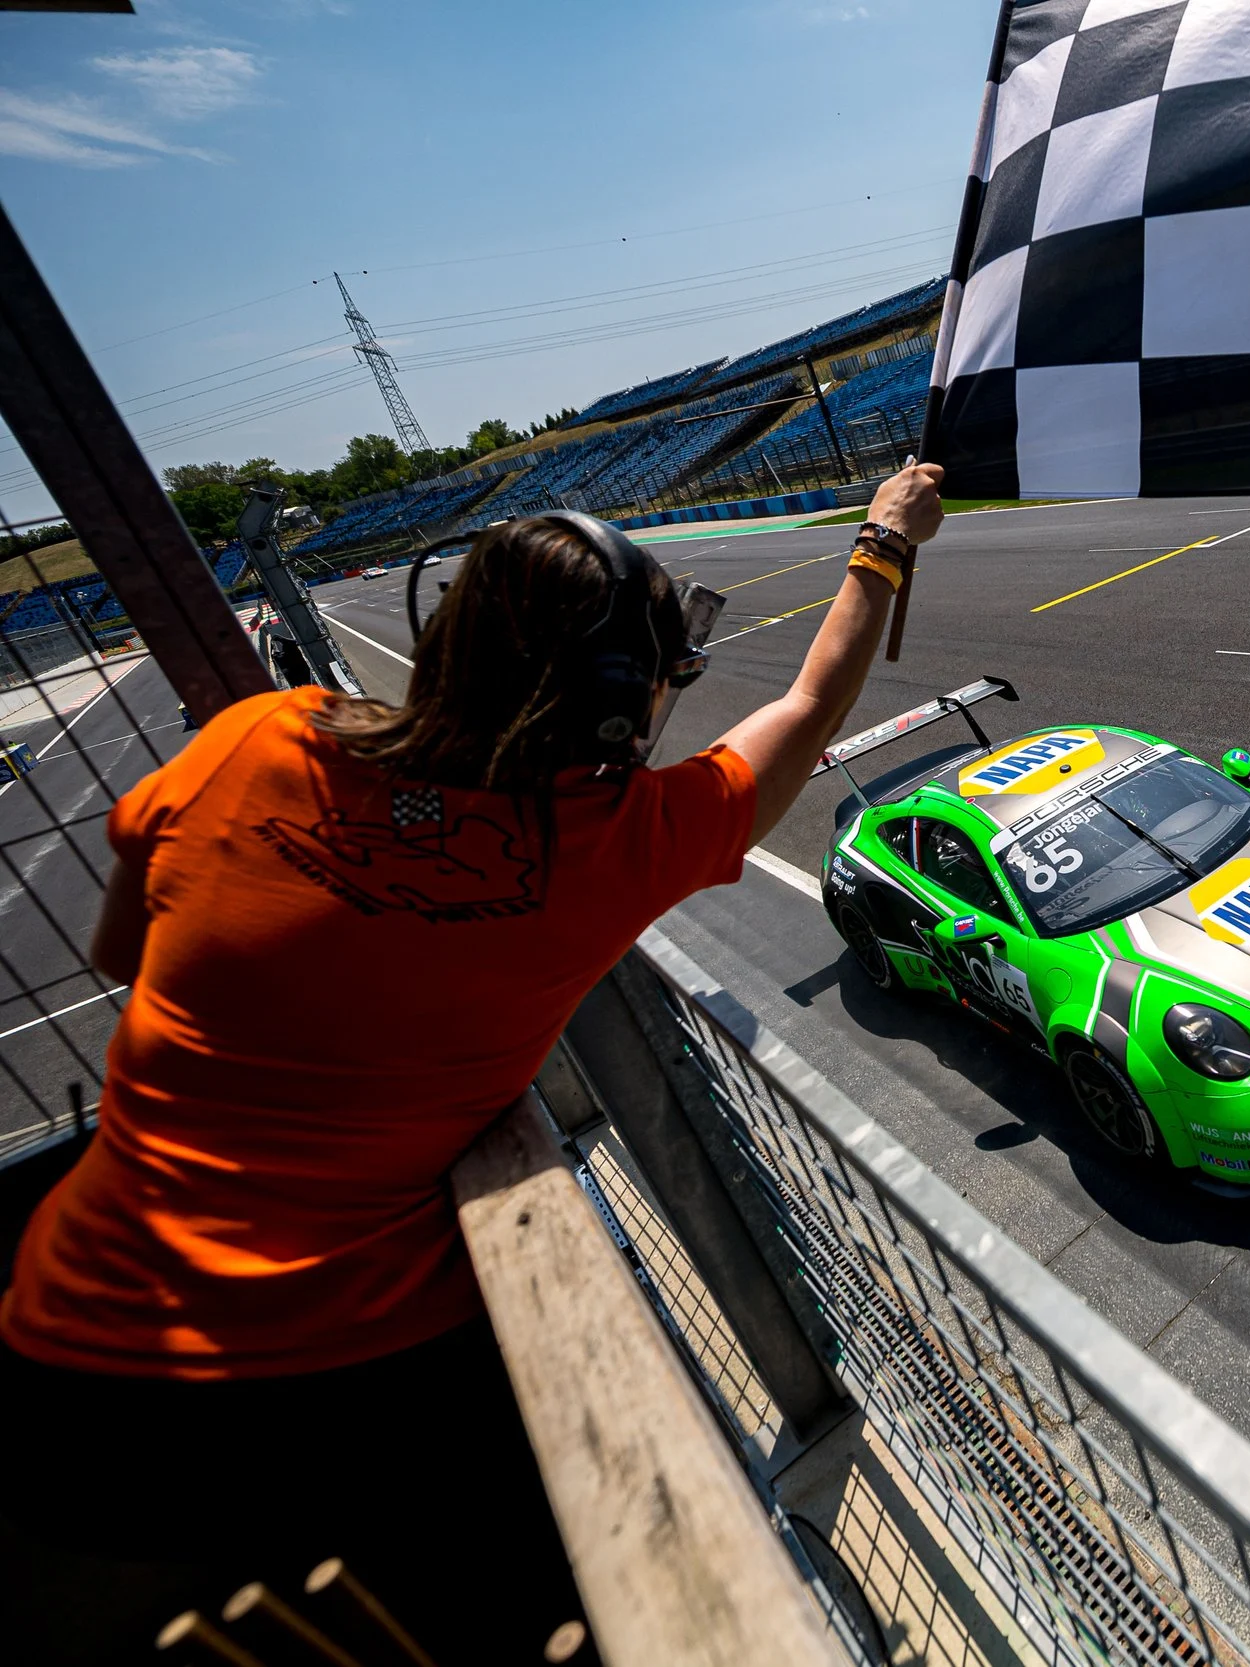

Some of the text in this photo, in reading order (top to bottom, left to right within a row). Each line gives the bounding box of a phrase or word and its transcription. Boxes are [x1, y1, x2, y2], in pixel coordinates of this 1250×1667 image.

[974, 736, 1086, 785] NAPA
[1009, 748, 1162, 836] PORSCHE
[831, 872, 856, 895] Going up!
[1026, 837, 1083, 893] 65
[1003, 978, 1031, 1013] 65
[1201, 1151, 1244, 1170] Mobil
